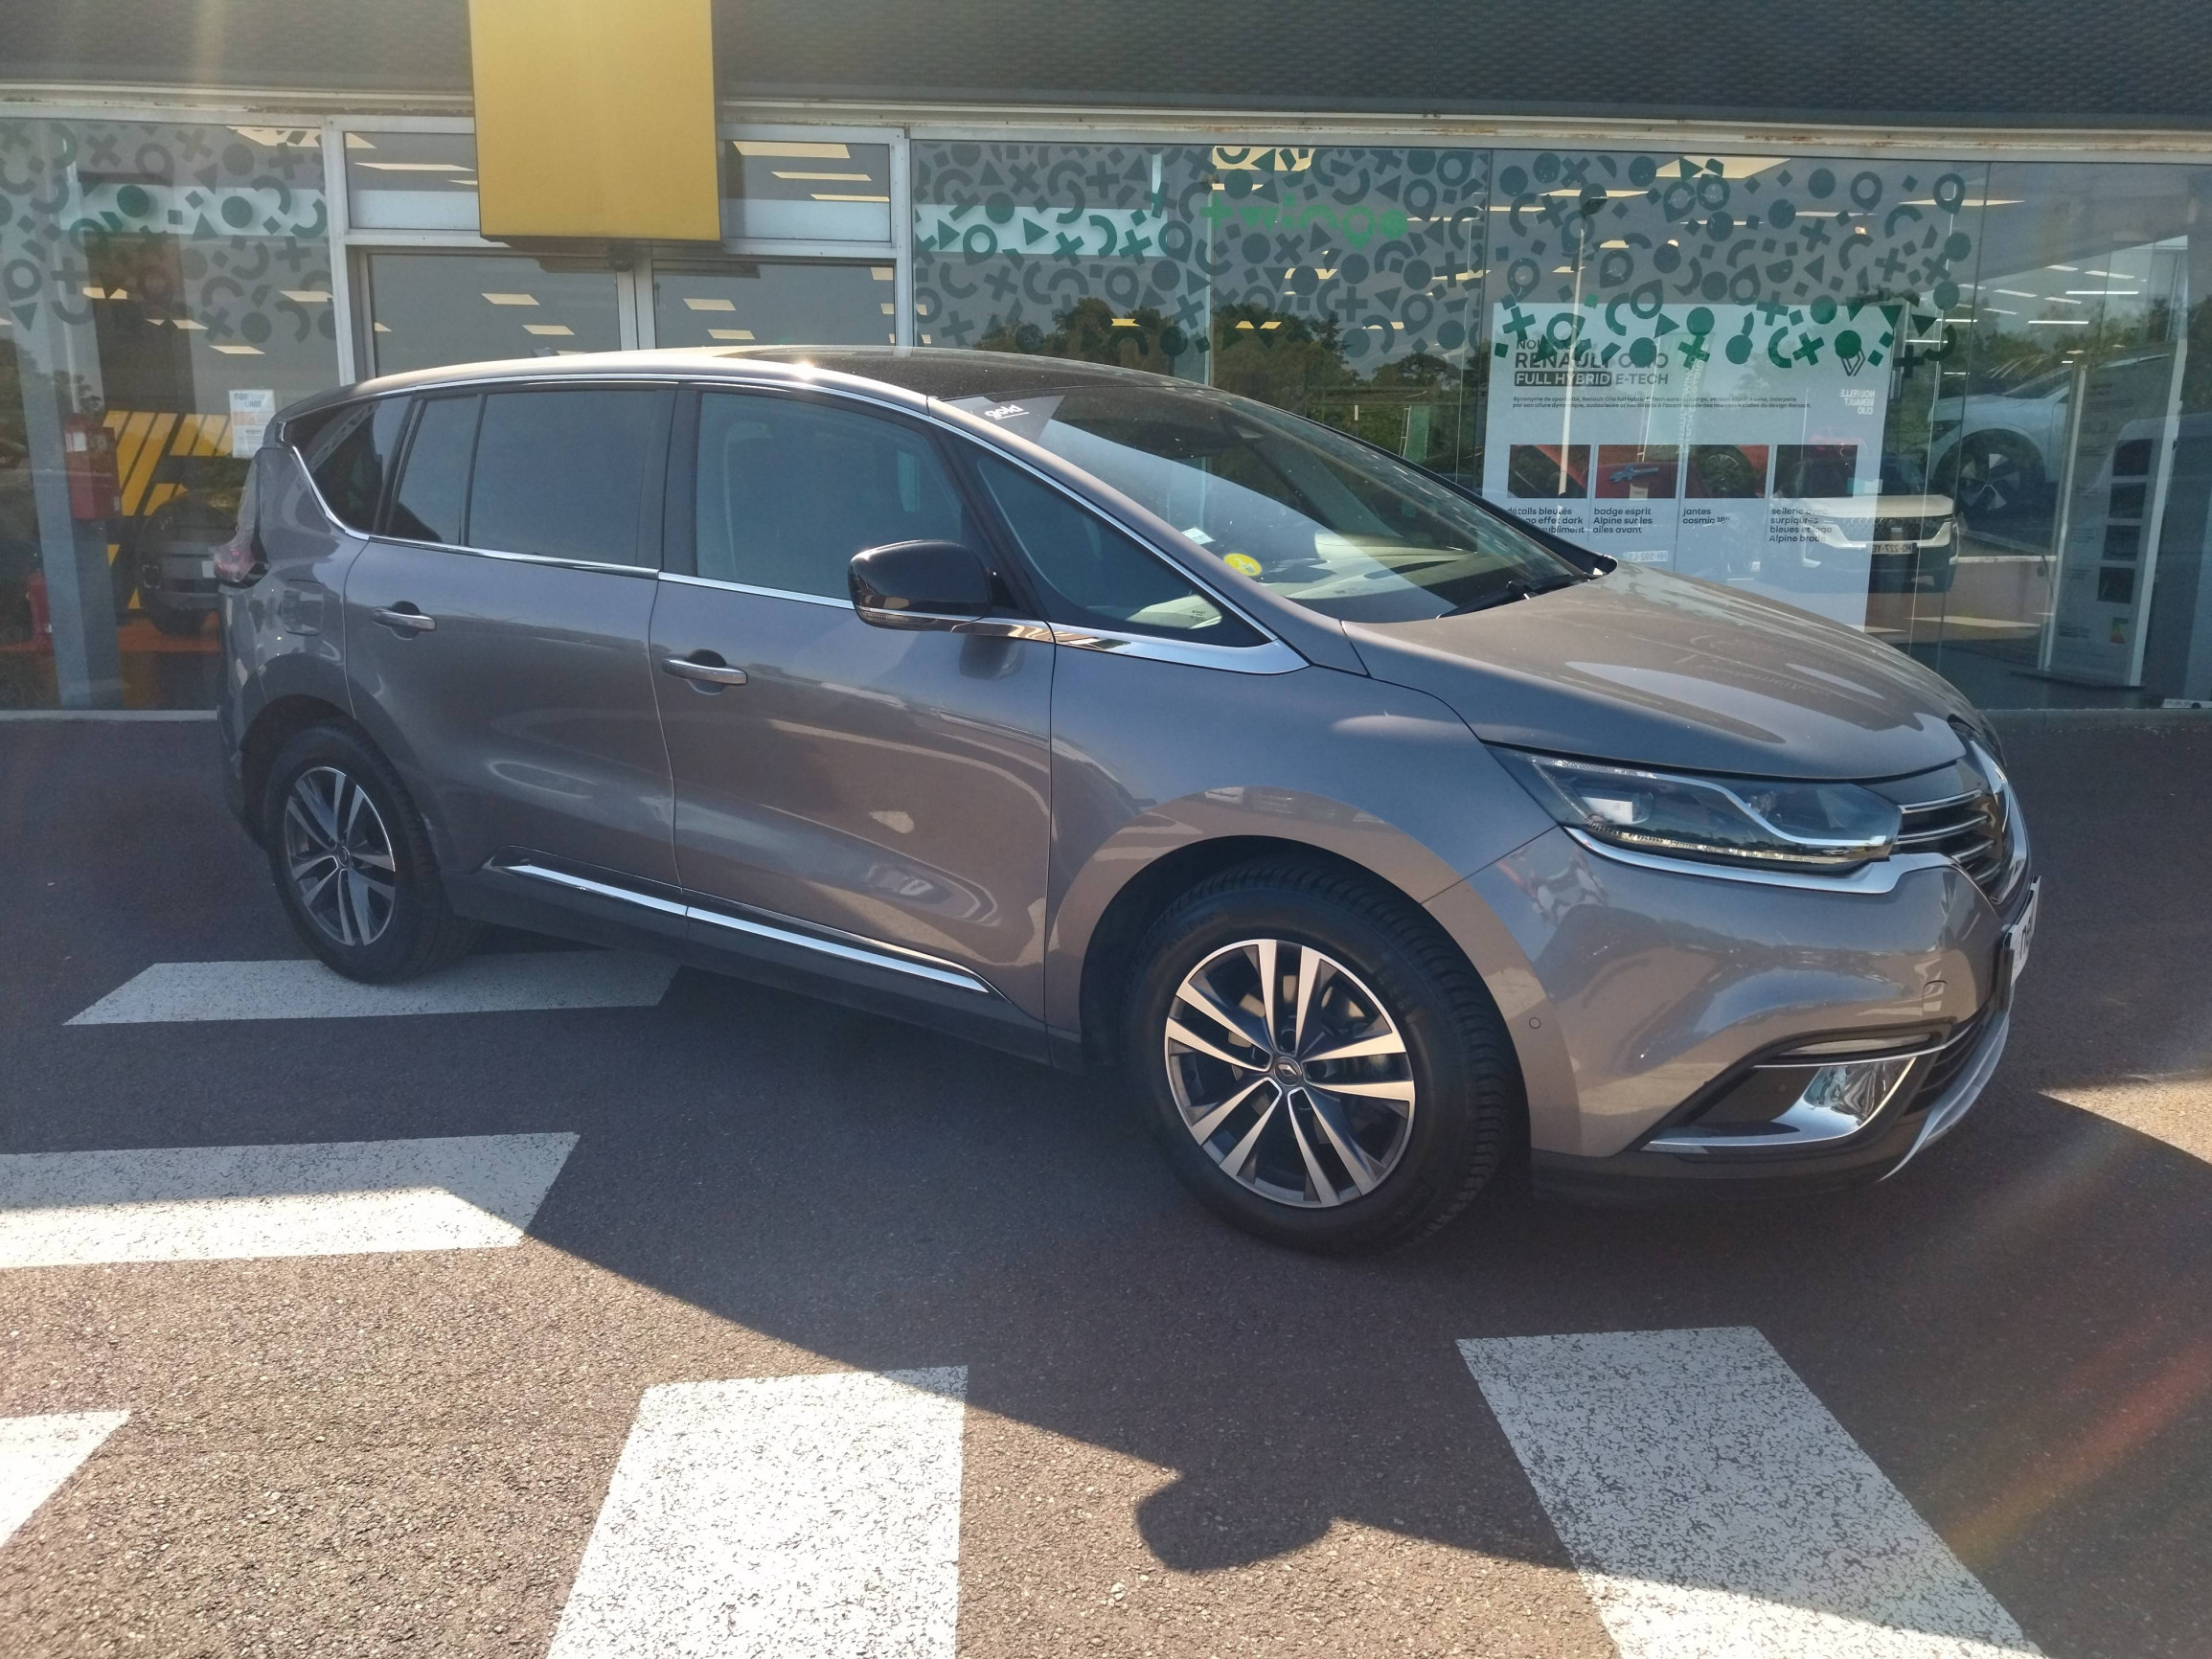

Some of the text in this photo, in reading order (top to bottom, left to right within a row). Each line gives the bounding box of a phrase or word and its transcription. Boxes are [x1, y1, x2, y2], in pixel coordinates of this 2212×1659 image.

[1515, 352, 1669, 369] RENAUL CO
[1516, 373, 1669, 385] FULL HYBRID E-TECH
[984, 404, 1024, 420] gold
[1507, 507, 1538, 515] détails
[1593, 507, 1652, 516] badge esprit
[1682, 507, 1712, 516] jantes
[1593, 516, 1623, 526] Alpine
[1592, 525, 1614, 534] ailes
[1769, 525, 1800, 534] bleues
[1768, 534, 1798, 544] Alpine
